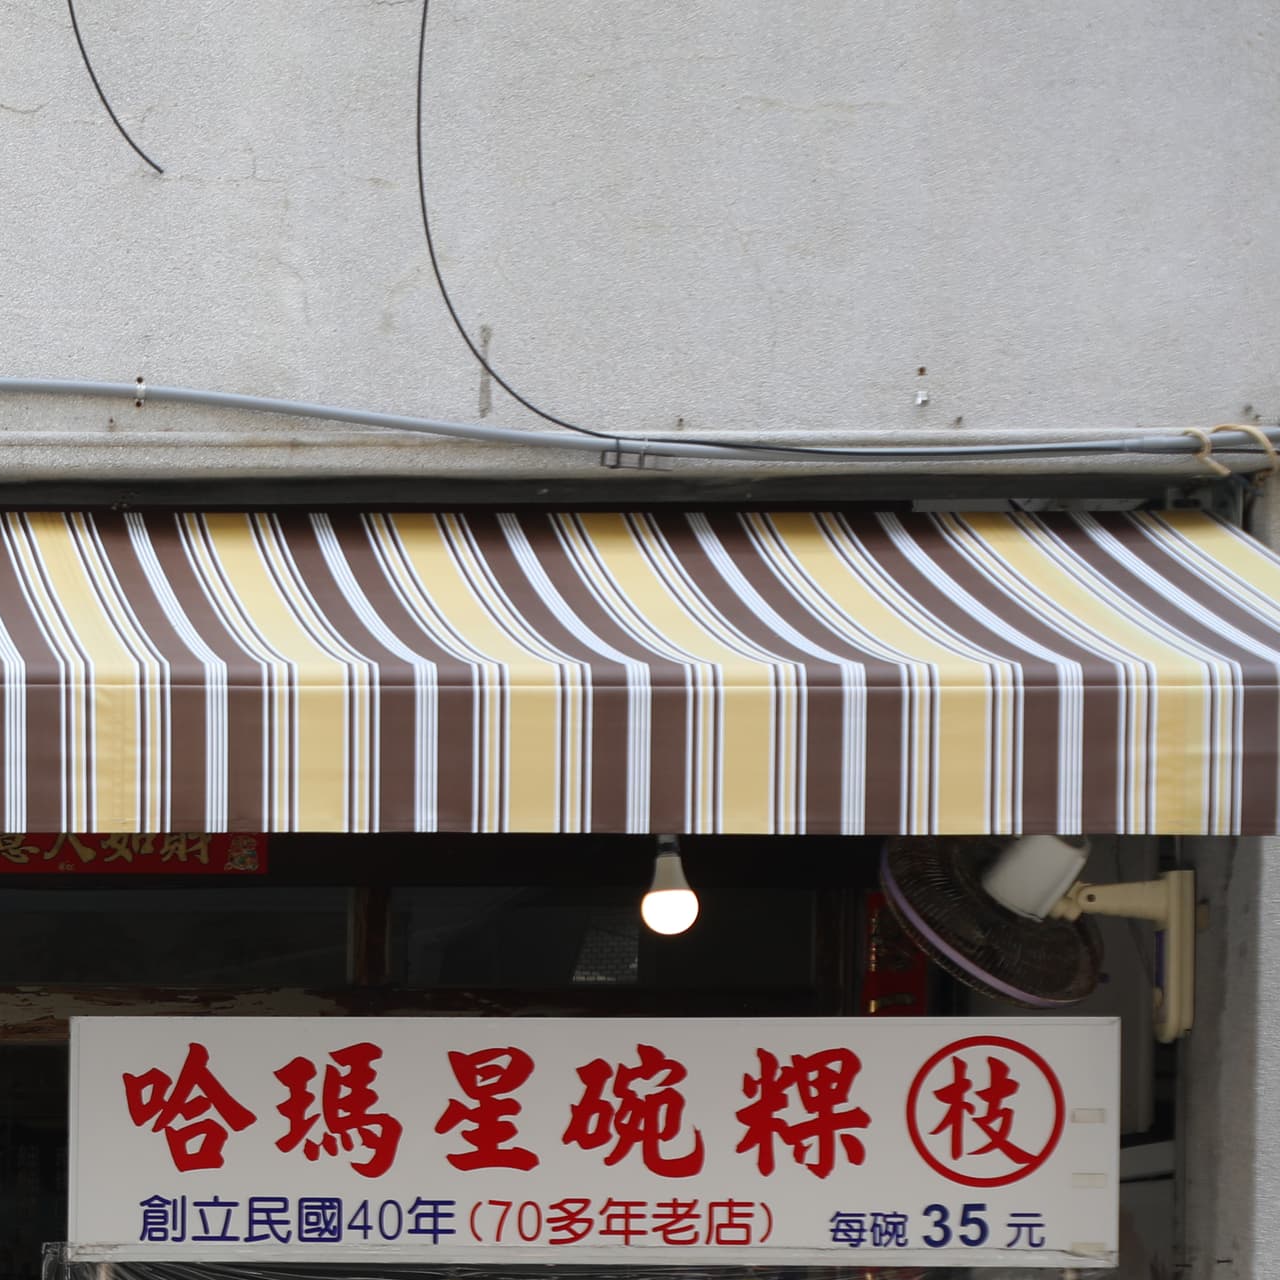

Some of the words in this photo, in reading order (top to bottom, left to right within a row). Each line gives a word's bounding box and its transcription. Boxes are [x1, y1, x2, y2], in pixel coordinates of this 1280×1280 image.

[121, 1041, 871, 1179] 哈瑪星碗粿
[930, 1055, 1040, 1166] 枝
[922, 1203, 990, 1249] 35
